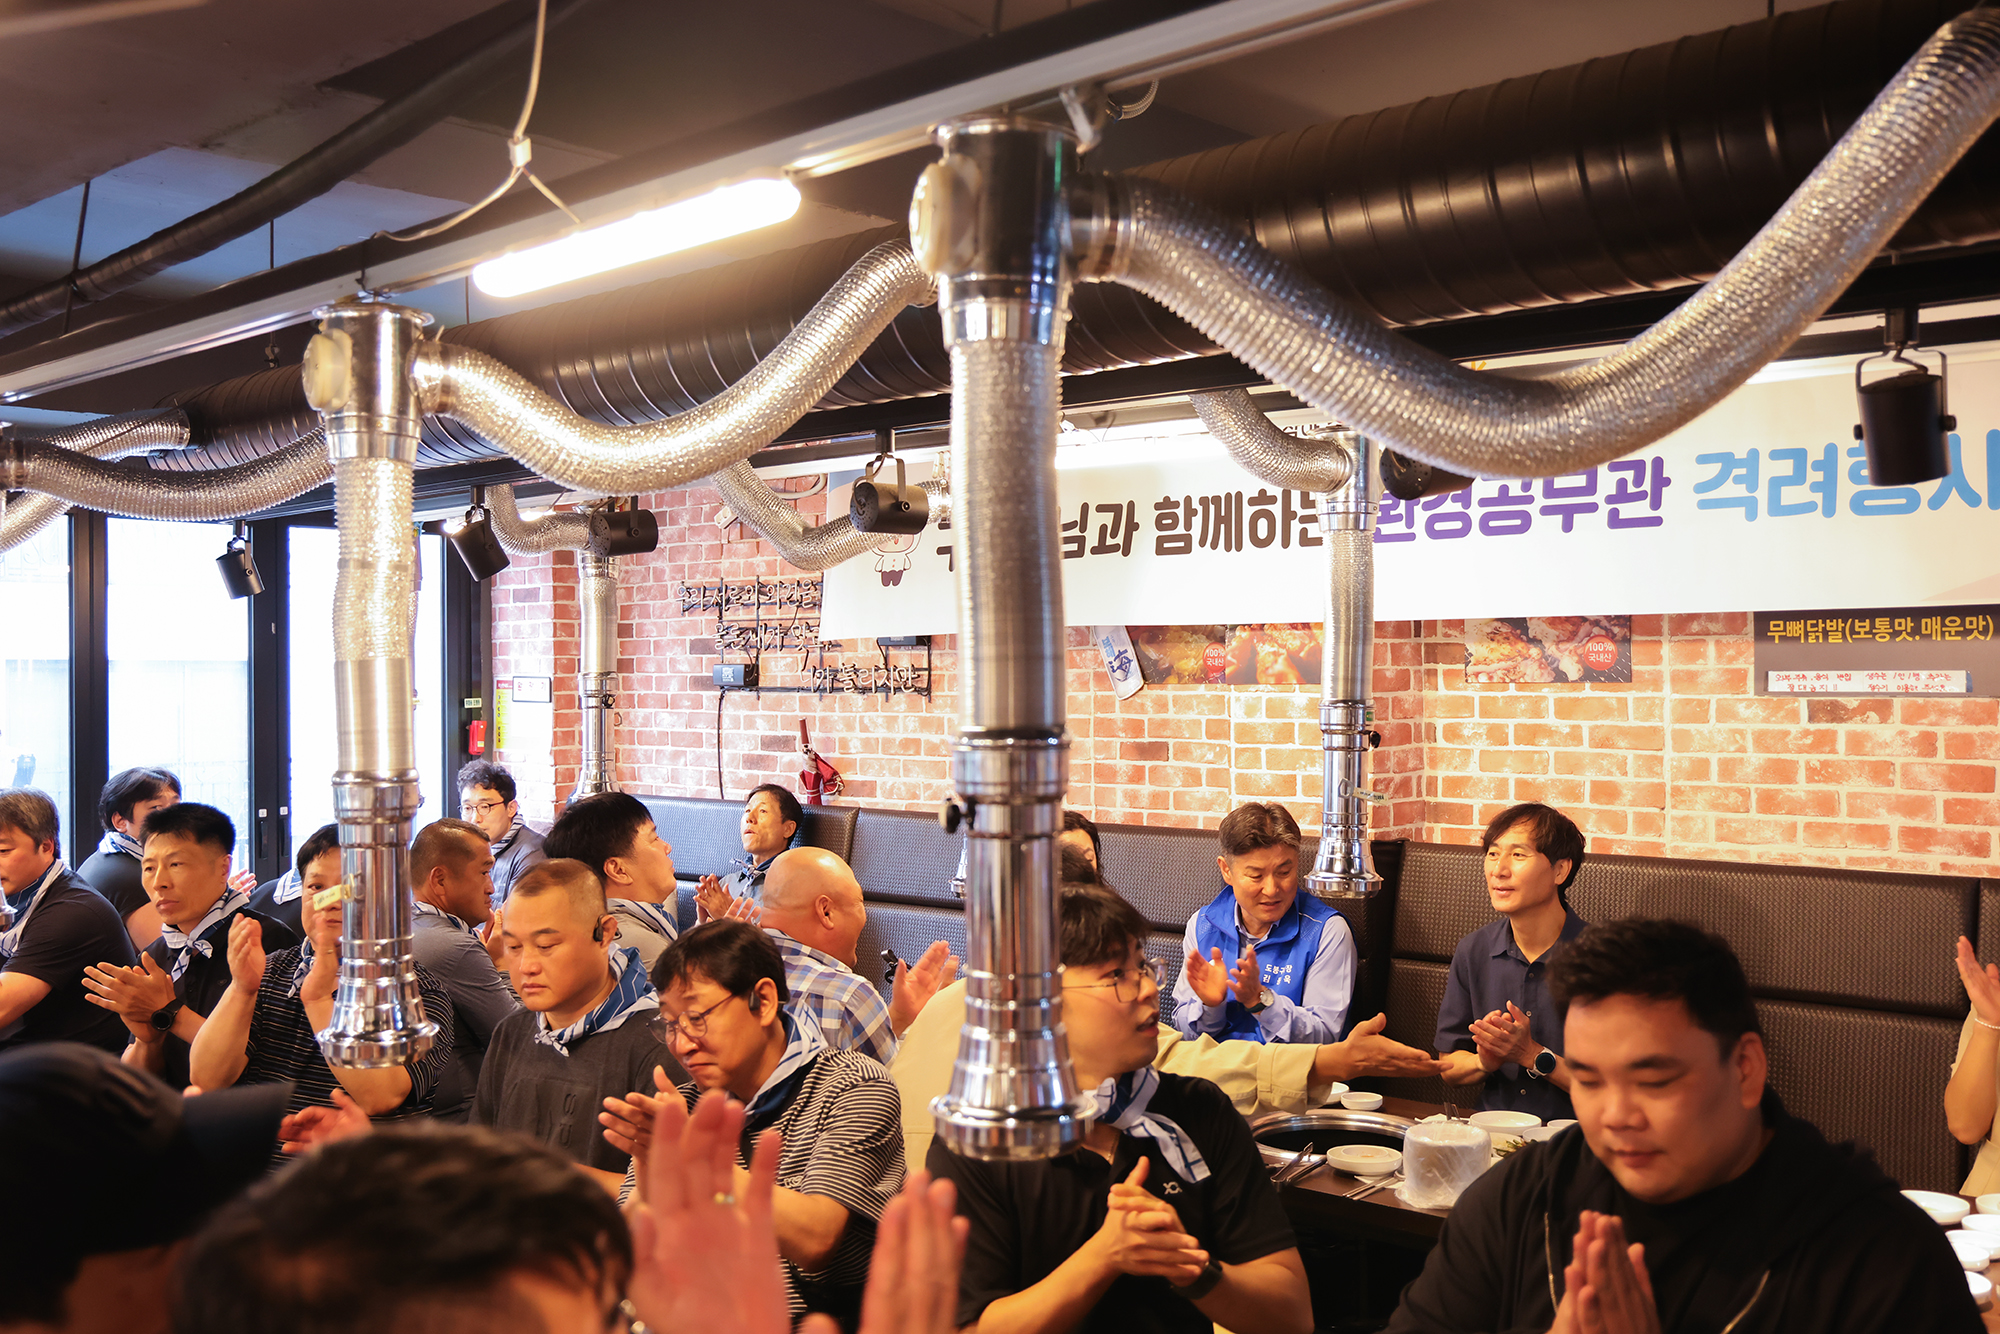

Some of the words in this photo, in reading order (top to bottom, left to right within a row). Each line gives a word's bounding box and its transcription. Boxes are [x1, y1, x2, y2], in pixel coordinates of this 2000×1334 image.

[1373, 456, 1671, 544] 환경공무관
[676, 585, 707, 613] 우리
[710, 581, 760, 612] 서로의
[766, 579, 815, 609] 의견을
[749, 623, 785, 652] 내가
[1588, 642, 1613, 652] 100%
[1206, 648, 1225, 657] 100%
[1206, 657, 1224, 667] 국내산
[1588, 653, 1612, 663] 국내산
[800, 665, 833, 693] 니가
[839, 663, 919, 695] 틀리지만
